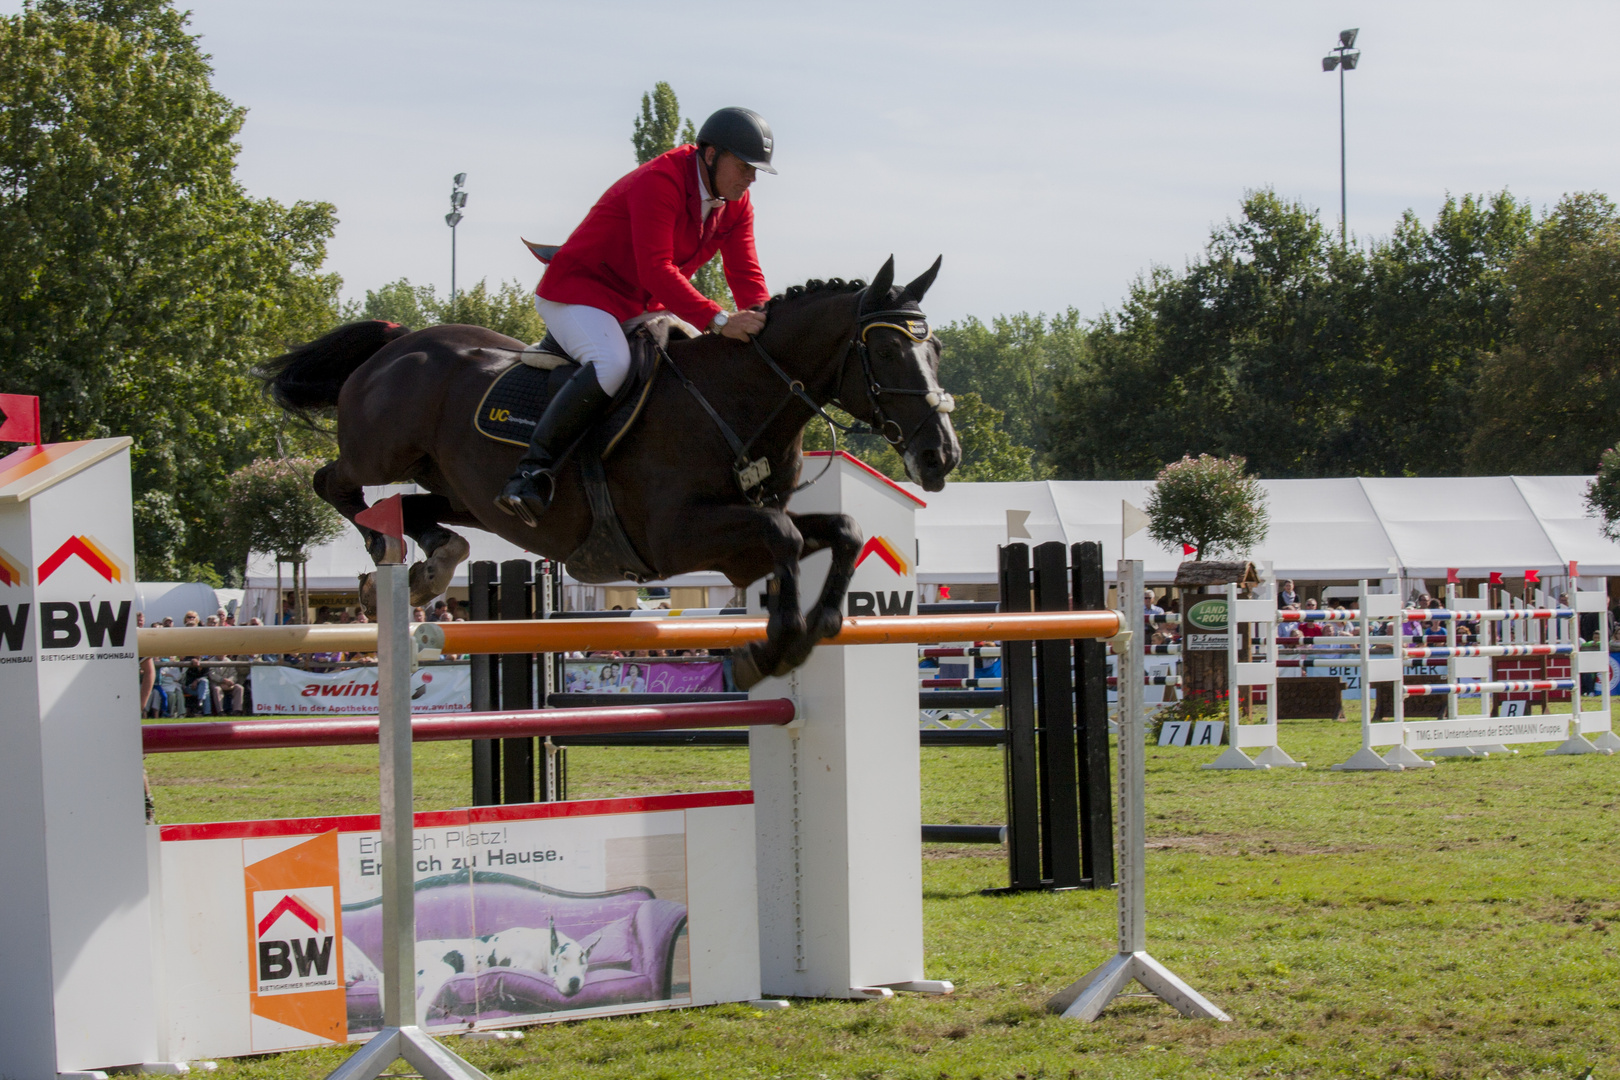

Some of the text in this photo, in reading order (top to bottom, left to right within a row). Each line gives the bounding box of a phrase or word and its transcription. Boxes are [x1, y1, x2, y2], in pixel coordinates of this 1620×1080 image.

[489, 408, 509, 422] UC
[0, 603, 30, 651] W
[40, 601, 131, 649] BW
[0, 656, 33, 664] OHNBAU
[41, 652, 134, 662] BIETIGHEIMER WOHNBAU
[301, 680, 379, 697] awint
[275, 704, 287, 712] Nr.
[299, 704, 308, 712] in
[1508, 704, 1517, 716] R
[1169, 725, 1212, 744] 7 A
[1416, 724, 1562, 740] TMG. Ein Unternehmen der EISENMANN Gruppe.
[446, 827, 508, 848] Platz!
[452, 856, 477, 869] zu
[488, 850, 564, 866] Hause.
[259, 936, 333, 980] BW
